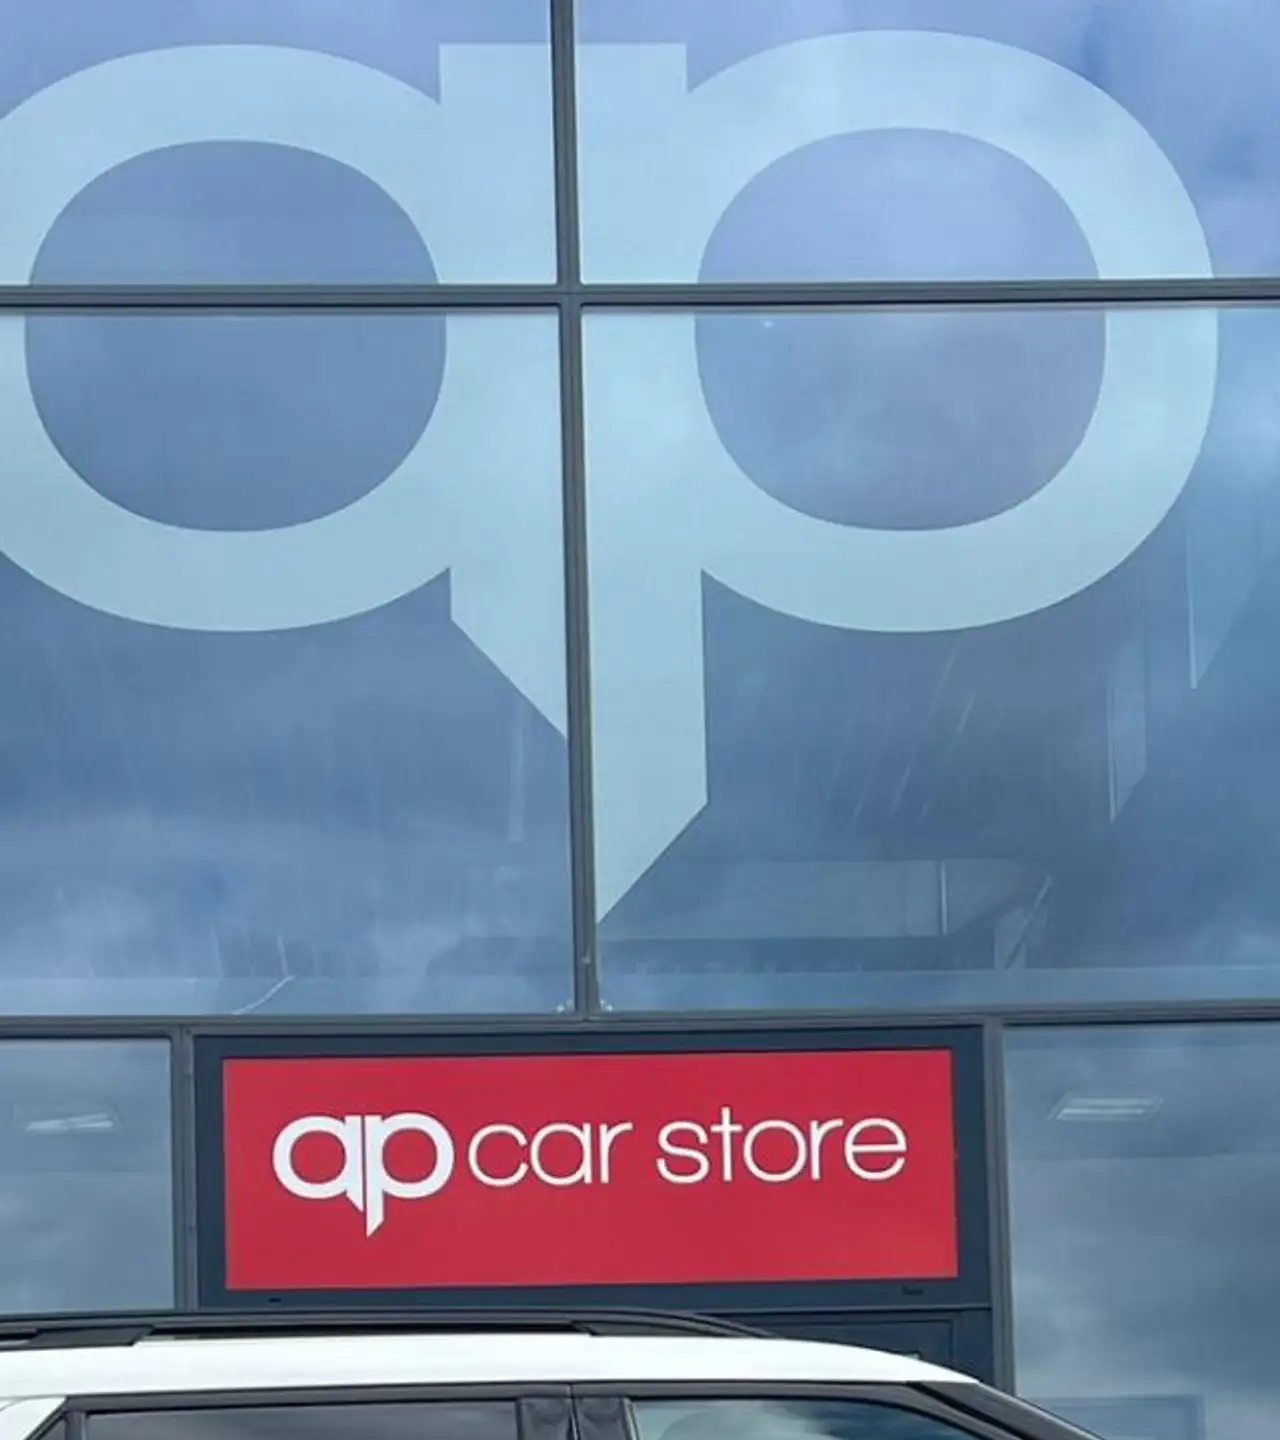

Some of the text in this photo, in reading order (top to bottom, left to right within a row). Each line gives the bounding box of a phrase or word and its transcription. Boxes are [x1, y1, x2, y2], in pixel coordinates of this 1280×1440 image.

[272, 1106, 907, 1238] ap car store
